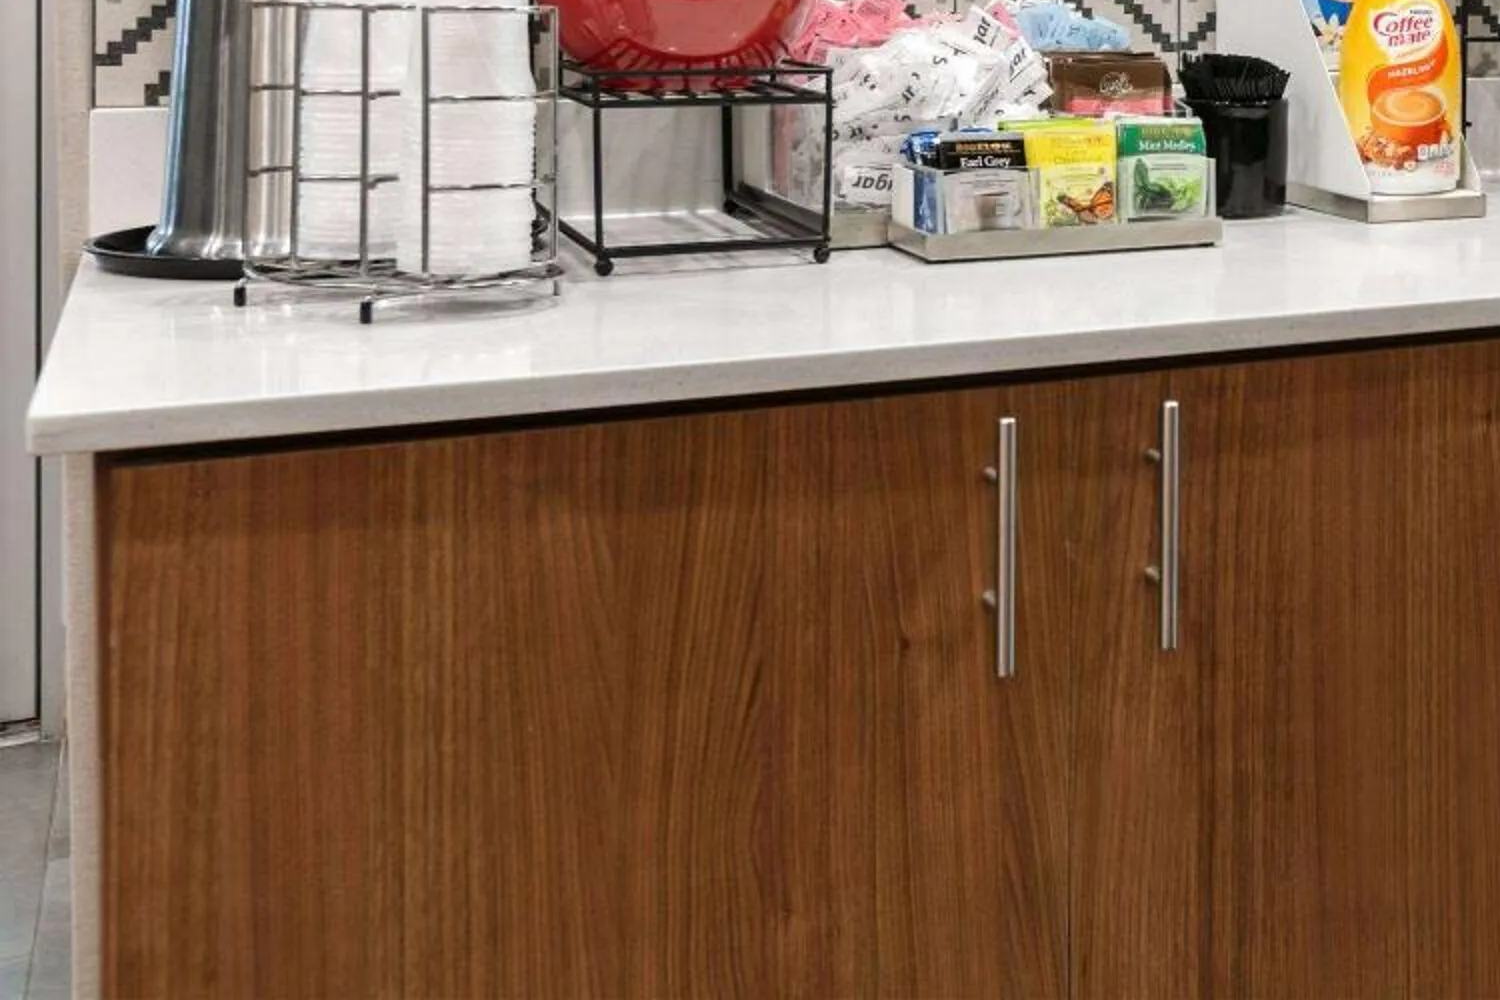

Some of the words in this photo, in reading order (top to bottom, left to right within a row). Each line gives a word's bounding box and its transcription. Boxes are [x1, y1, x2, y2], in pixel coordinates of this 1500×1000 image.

[1373, 12, 1433, 37] Coffee
[1388, 31, 1431, 47] mate
[960, 155, 983, 168] Earl
[984, 155, 1012, 168] Grey
[852, 173, 893, 191] gar
